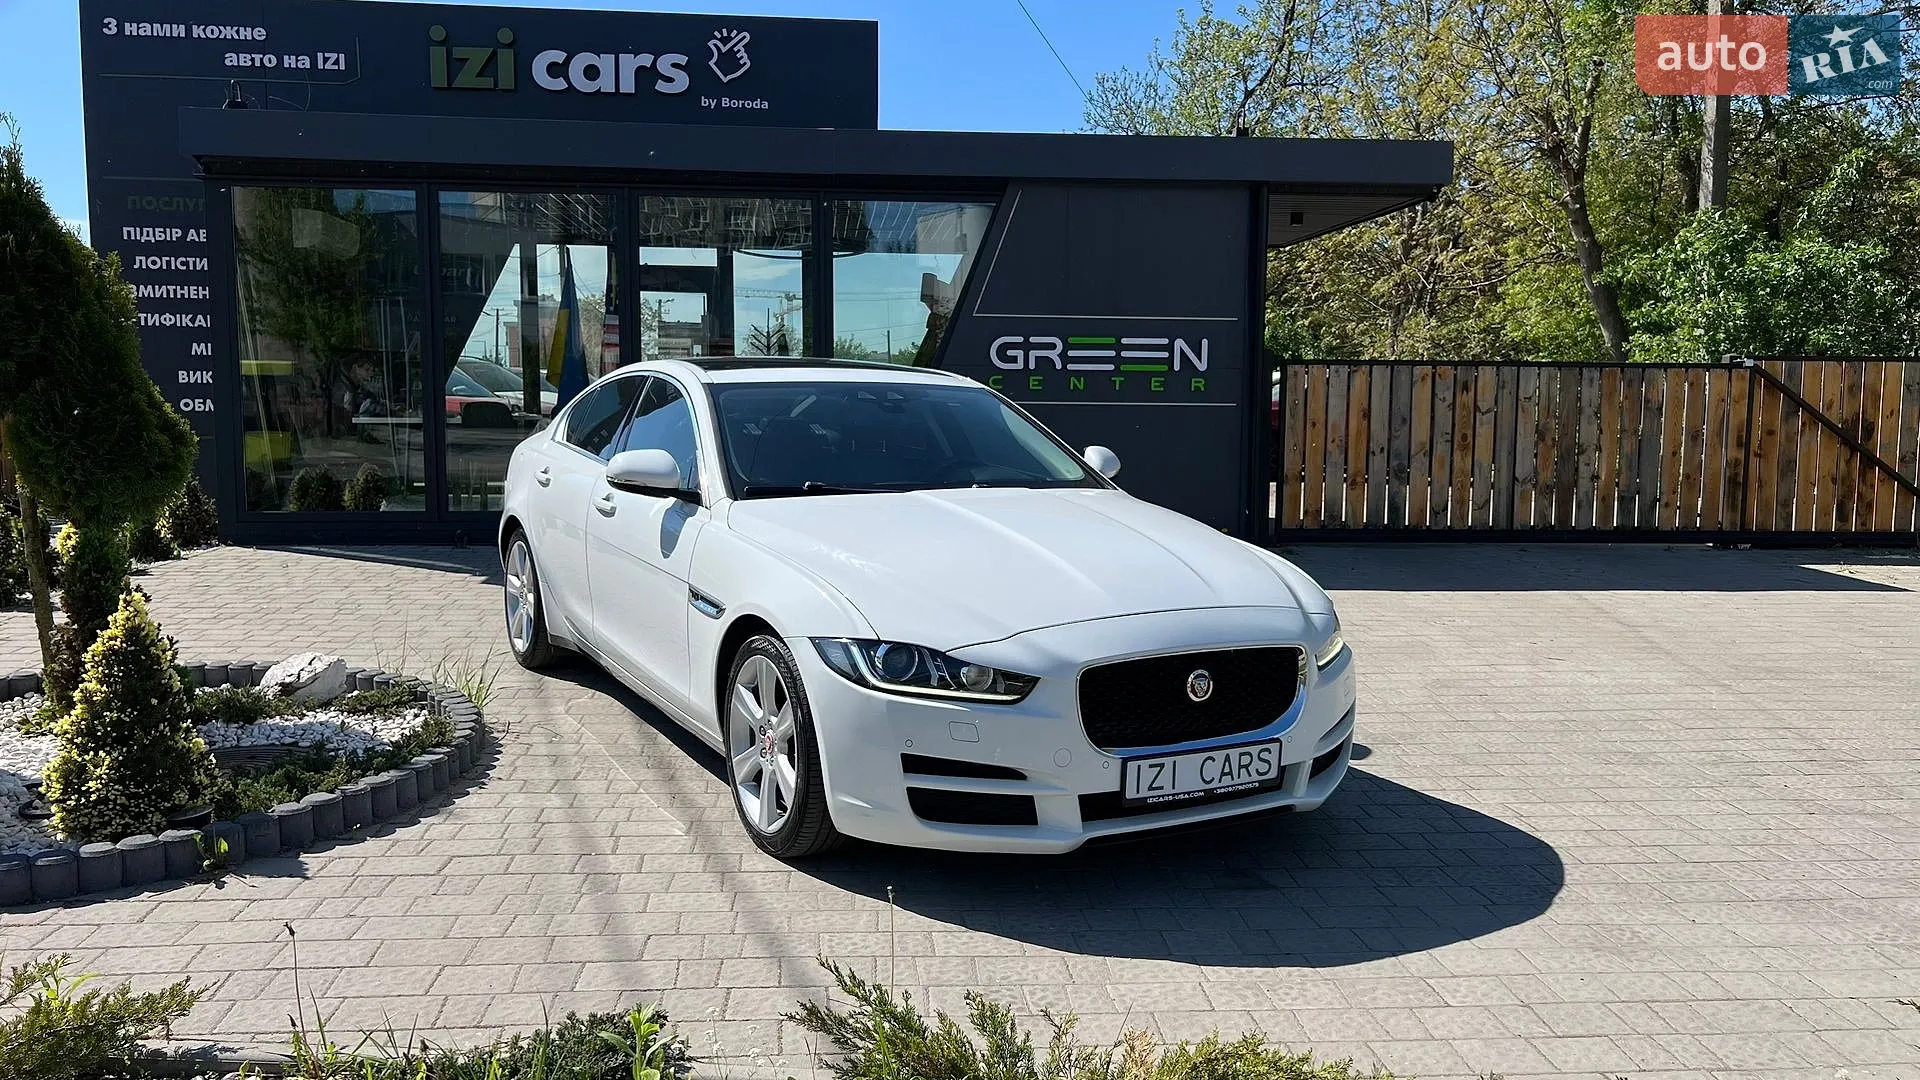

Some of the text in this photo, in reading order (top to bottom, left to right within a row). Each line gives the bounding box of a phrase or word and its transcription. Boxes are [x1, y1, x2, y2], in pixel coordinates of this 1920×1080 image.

[102, 17, 267, 42] З нами кожне
[223, 50, 346, 71] авто на IZI
[428, 24, 690, 94] izi cars
[700, 95, 769, 110] by Boroda
[122, 226, 182, 243] ПІДБІР
[133, 255, 209, 271] ЛОГІСТИ
[989, 335, 1209, 372] GREEN
[988, 375, 1206, 392] CENTER
[1136, 747, 1272, 795] IZI CARS
